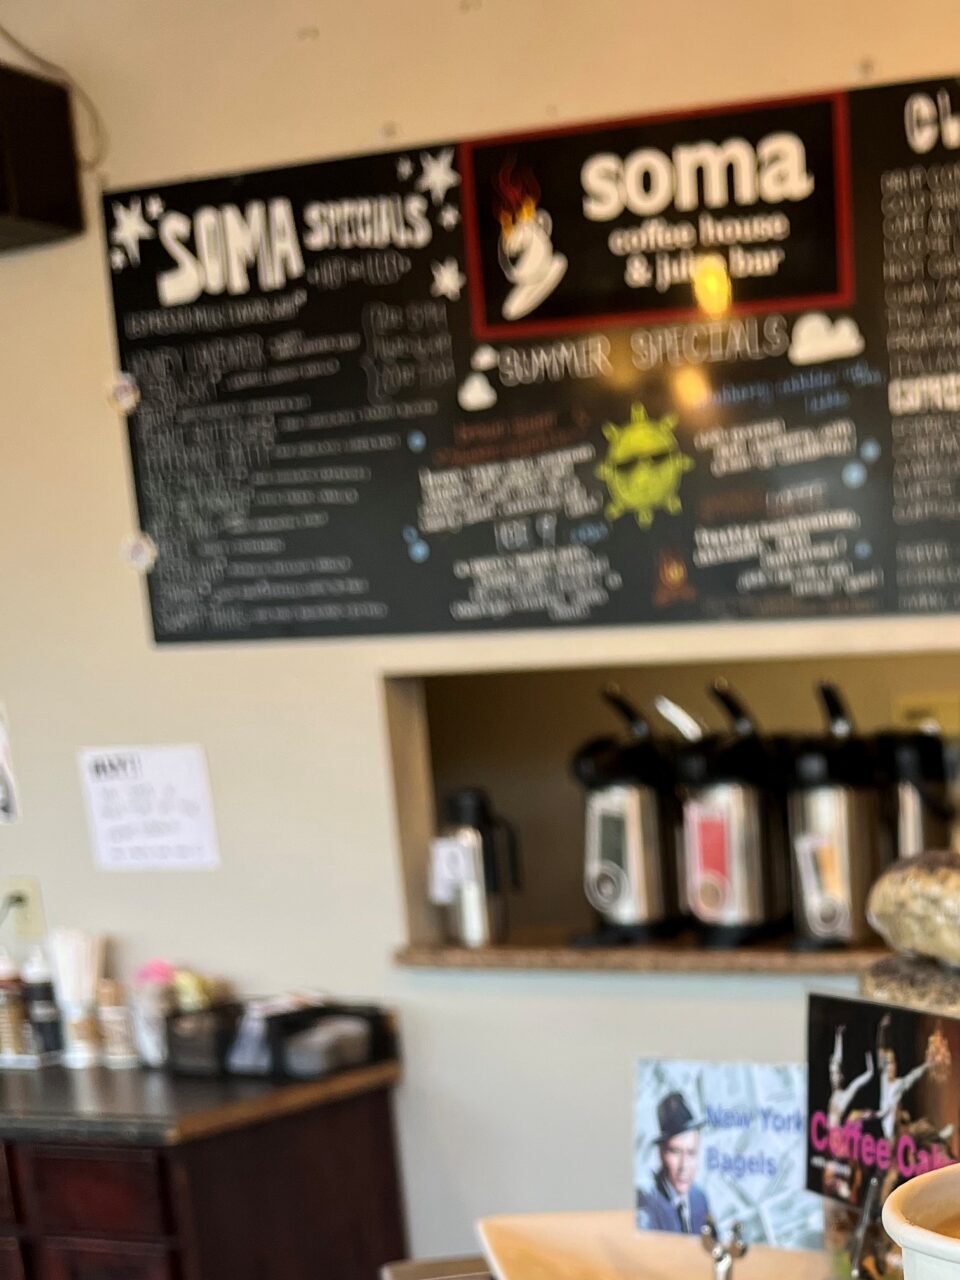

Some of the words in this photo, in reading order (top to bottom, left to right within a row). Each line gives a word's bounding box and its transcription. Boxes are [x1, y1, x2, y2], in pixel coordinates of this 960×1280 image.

[580, 131, 815, 221] soma
[156, 197, 306, 308] SOMA
[303, 193, 434, 251] SPECIALS
[608, 216, 697, 256] coffee
[699, 211, 790, 247] house
[624, 253, 653, 288] &
[655, 250, 726, 293] jui
[729, 245, 785, 278] bar
[499, 332, 614, 386] SUMMER
[631, 314, 789, 371] SPECIALS
[706, 1146, 777, 1179] Bagels
[810, 1111, 892, 1171] Coffee
[897, 1135, 959, 1178] Cak
